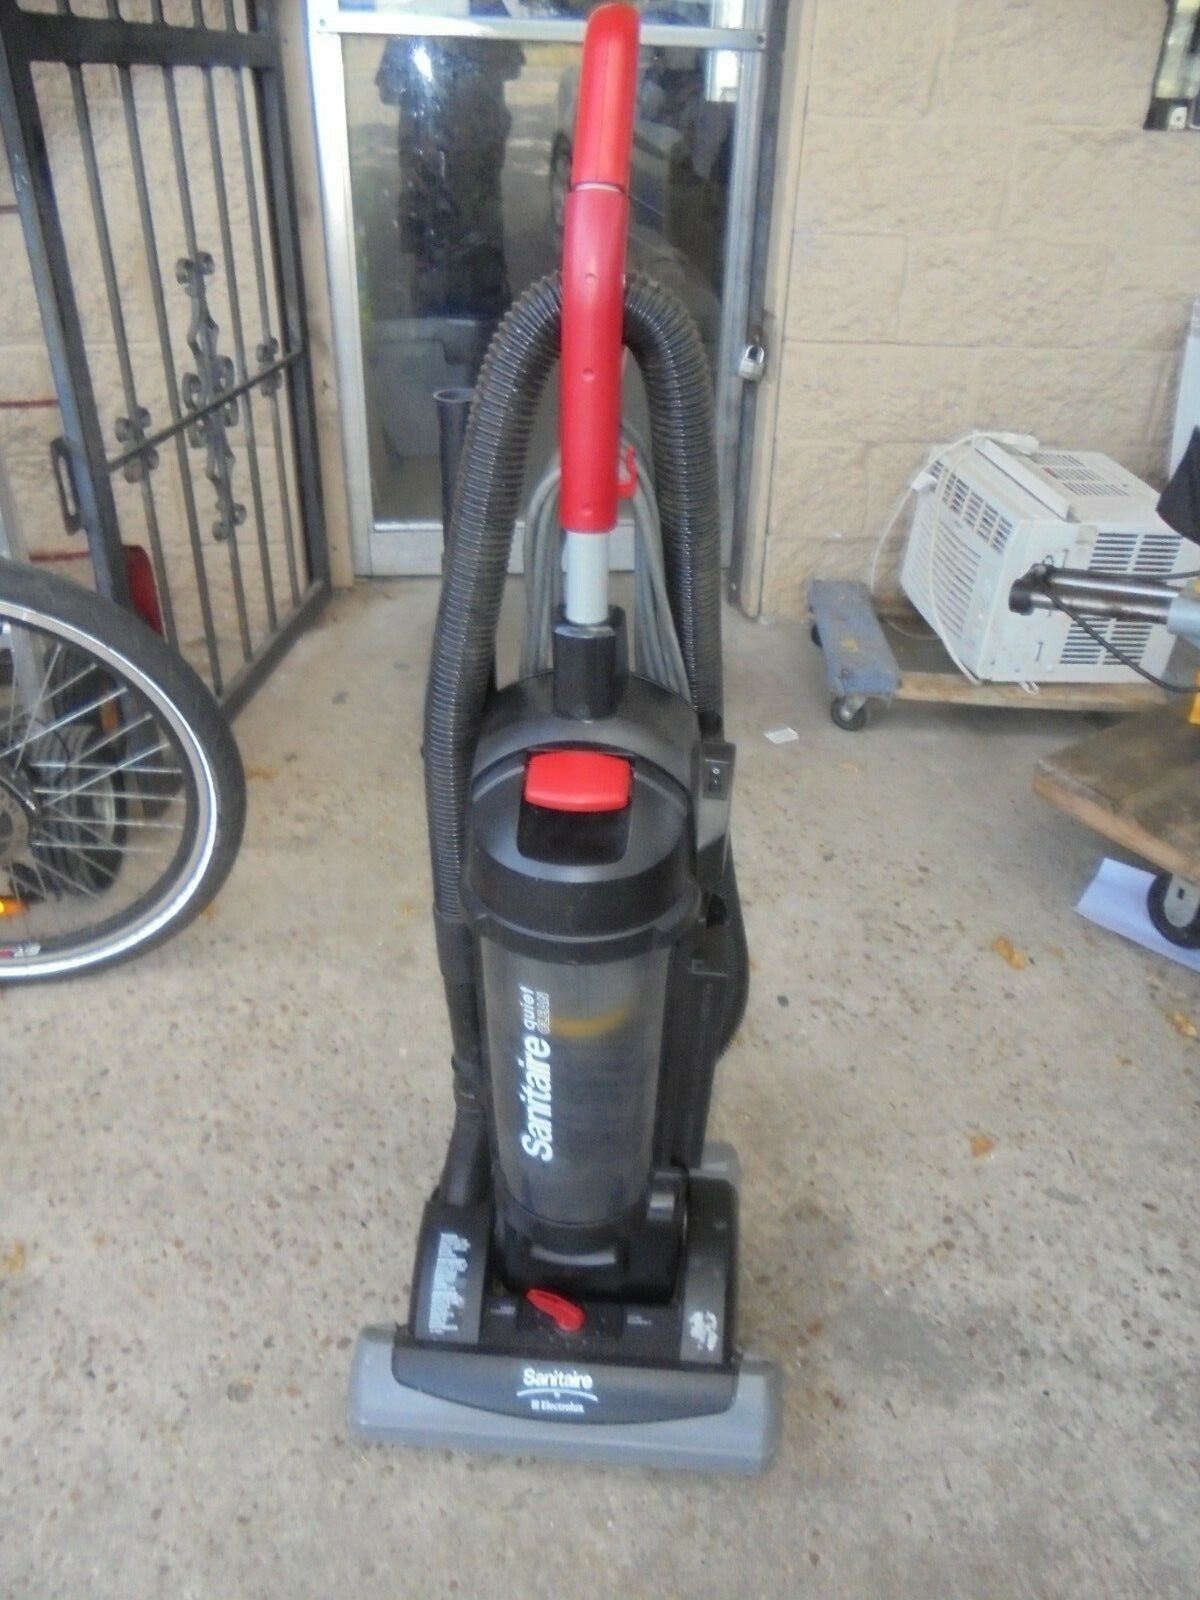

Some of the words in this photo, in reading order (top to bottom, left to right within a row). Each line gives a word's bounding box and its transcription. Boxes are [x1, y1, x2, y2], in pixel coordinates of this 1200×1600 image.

[519, 986, 536, 1031] quiet
[517, 1036, 553, 1161] Sanitaire
[522, 1368, 593, 1389] Sanitaire
